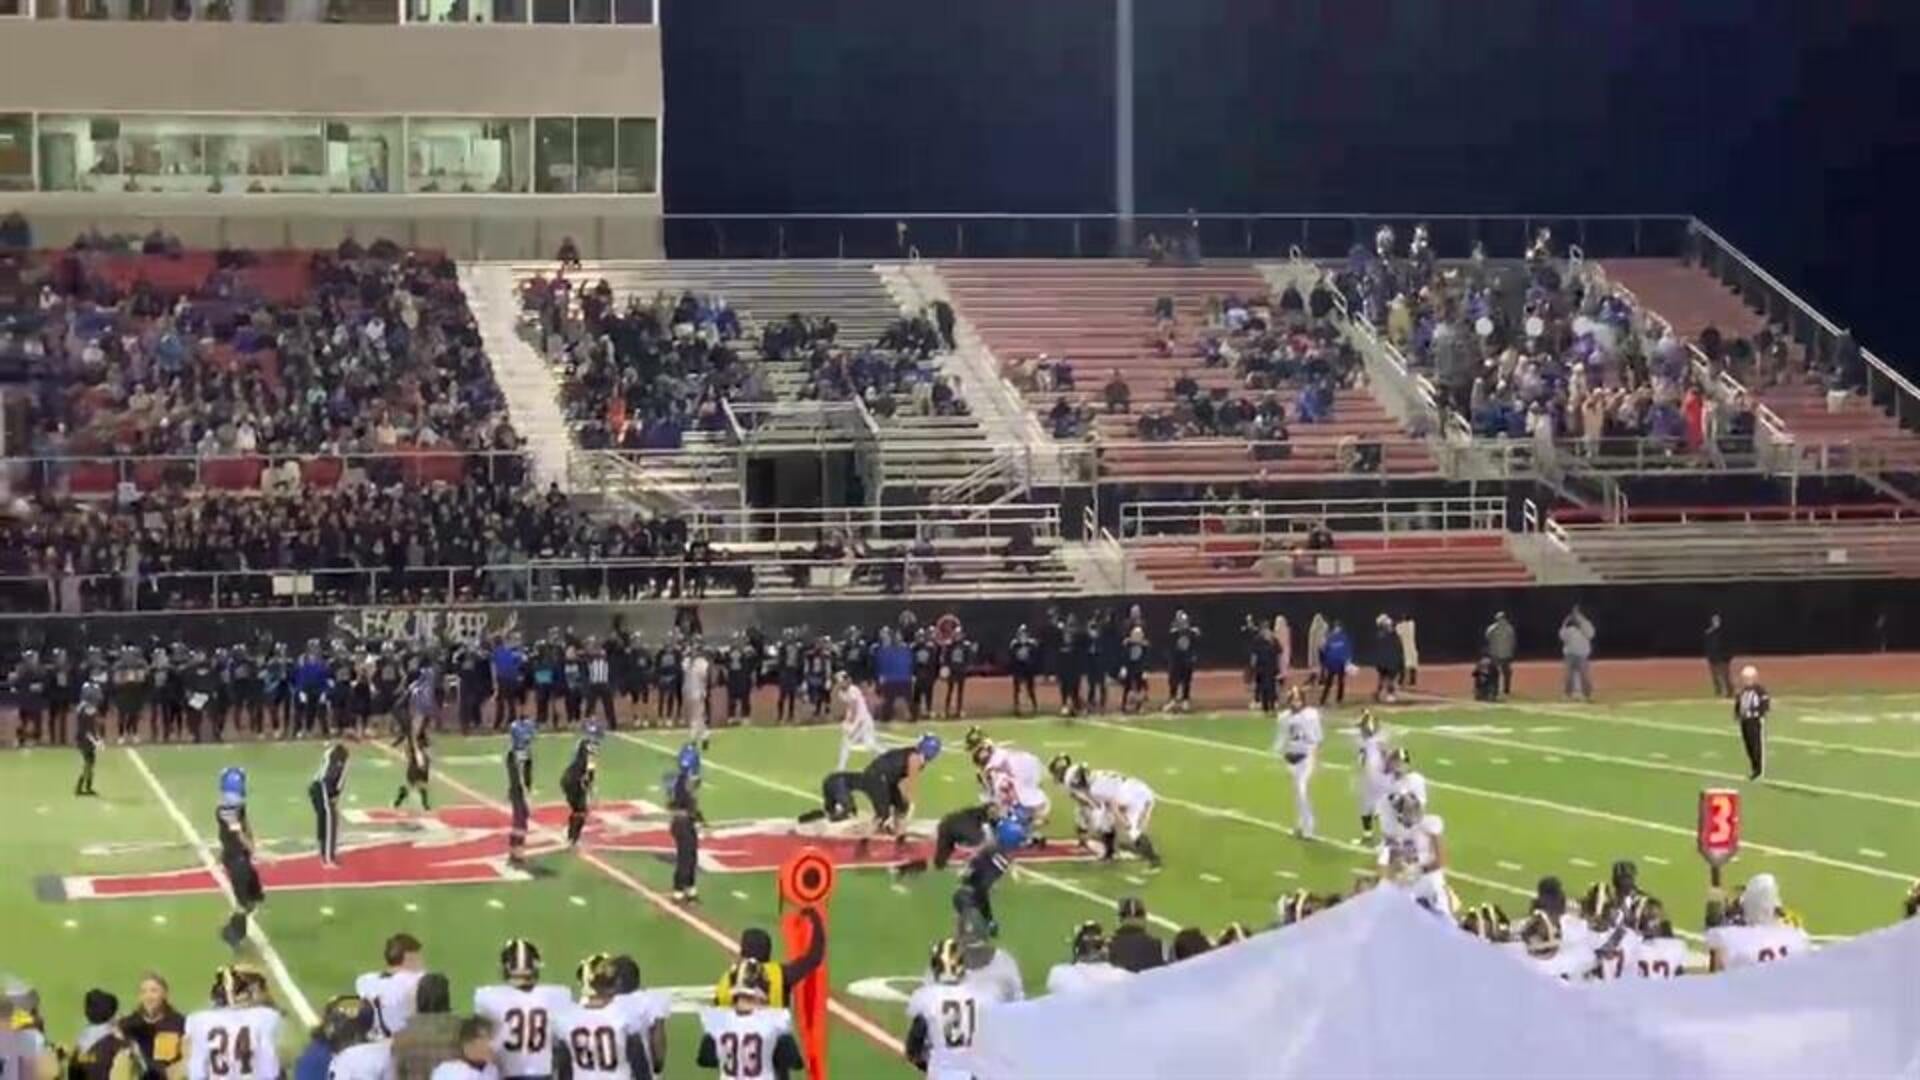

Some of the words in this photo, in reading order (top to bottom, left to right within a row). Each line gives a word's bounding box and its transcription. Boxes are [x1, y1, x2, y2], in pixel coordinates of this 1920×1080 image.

[1709, 796, 1732, 843] 3
[504, 1008, 548, 1052] 38
[942, 997, 975, 1047] 21
[208, 1025, 253, 1076] 24
[570, 1026, 618, 1072] 60
[720, 1032, 763, 1078] 33
